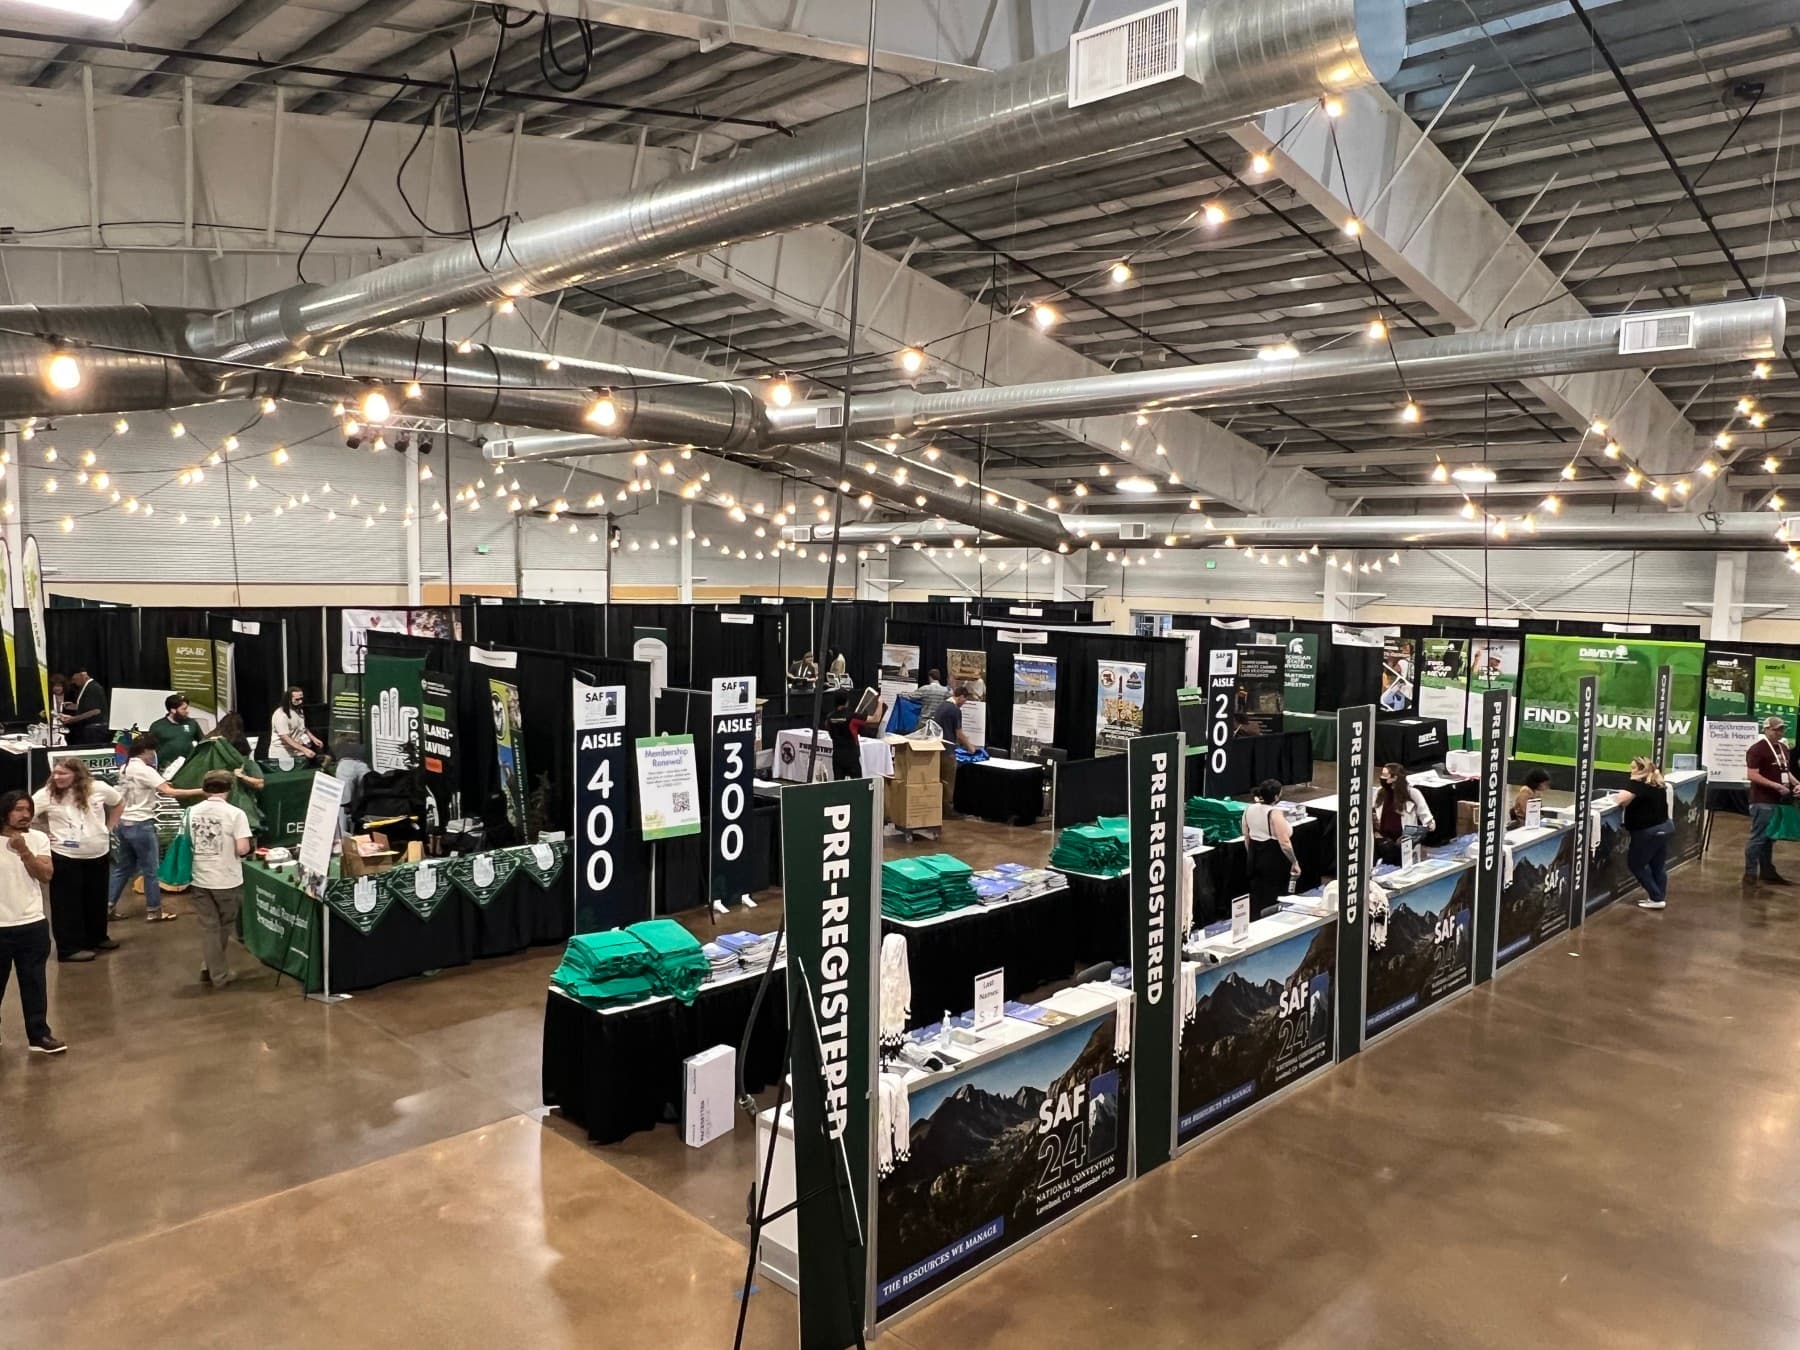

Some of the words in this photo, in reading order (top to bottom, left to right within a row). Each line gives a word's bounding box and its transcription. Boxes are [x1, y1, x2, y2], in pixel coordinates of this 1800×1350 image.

[1579, 648, 1615, 658] DAVEY
[585, 692, 604, 702] SAF
[721, 682, 737, 692] SAF
[1212, 677, 1235, 687] AISLE
[717, 718, 753, 734] AISLE
[1523, 707, 1571, 724] FIND
[1582, 686, 1592, 752] ONSITE
[580, 732, 622, 750] AISLE
[1211, 693, 1229, 774] 200
[1731, 732, 1756, 740] Hours
[644, 747, 688, 758] Membership
[652, 756, 683, 767] Renewal
[1484, 701, 1502, 871] PRE-REGISTERED
[720, 742, 745, 861] 300
[586, 759, 614, 891] 400
[1346, 720, 1363, 925] PRE-REGISTERED
[1574, 758, 1588, 891] REGISTRATION
[1147, 752, 1168, 1006] PRE-REGISTERED
[1544, 869, 1560, 894] SAF
[1434, 915, 1456, 945] SAF
[979, 990, 999, 1000] Names
[983, 980, 995, 989] Last
[1279, 981, 1309, 1019] SAF
[1277, 1010, 1309, 1062] 24
[1038, 1083, 1087, 1134] SAF
[1037, 1121, 1087, 1190] 24
[1036, 1178, 1071, 1203] NATIONAL
[1071, 1154, 1115, 1184] CONVENTION
[1062, 1190, 1071, 1200] CO
[882, 1279, 901, 1296] THE
[902, 1251, 950, 1286] RESOURCES
[951, 1243, 964, 1257] WE
[965, 1224, 998, 1250] MANAGE
